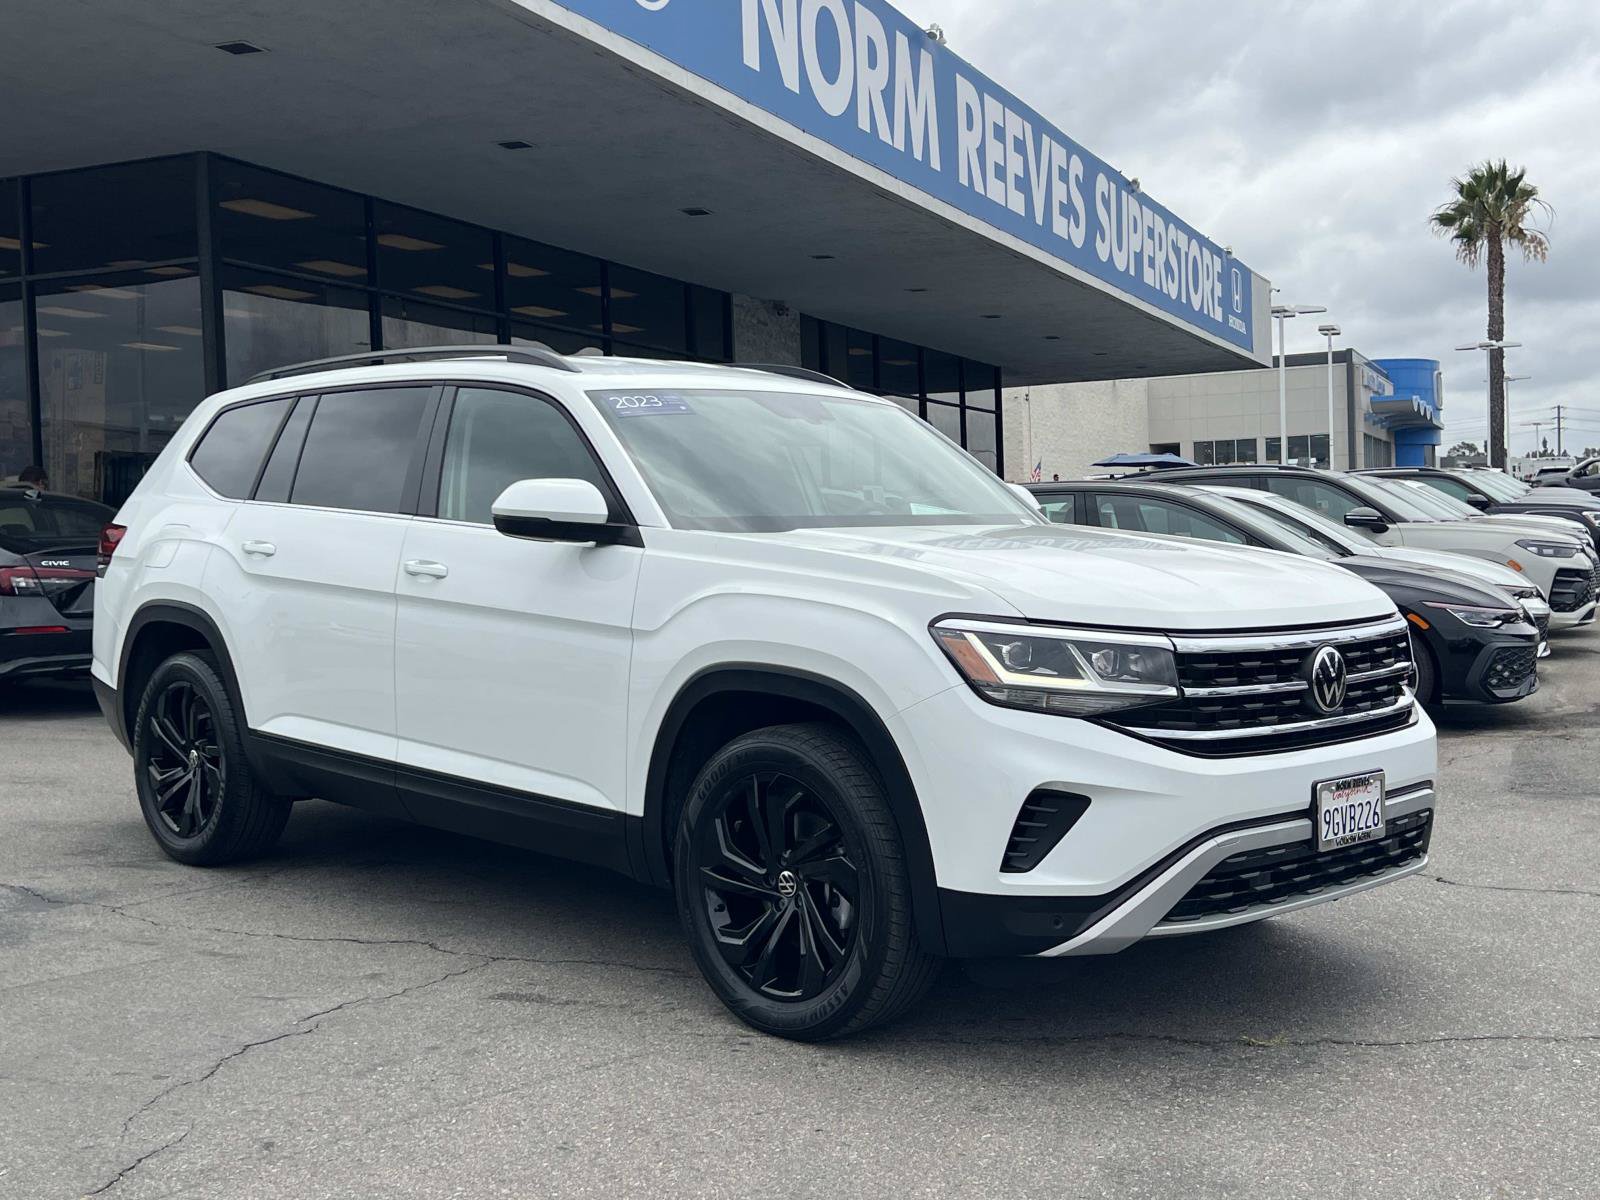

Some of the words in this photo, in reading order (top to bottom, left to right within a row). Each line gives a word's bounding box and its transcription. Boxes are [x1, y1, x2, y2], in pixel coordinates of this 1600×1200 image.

[741, 0, 941, 172] NORM
[956, 73, 1086, 248] REEVES
[1095, 173, 1223, 322] SUPERSTORE
[609, 395, 663, 409] 2023
[1323, 798, 1380, 839] 9GVB226
